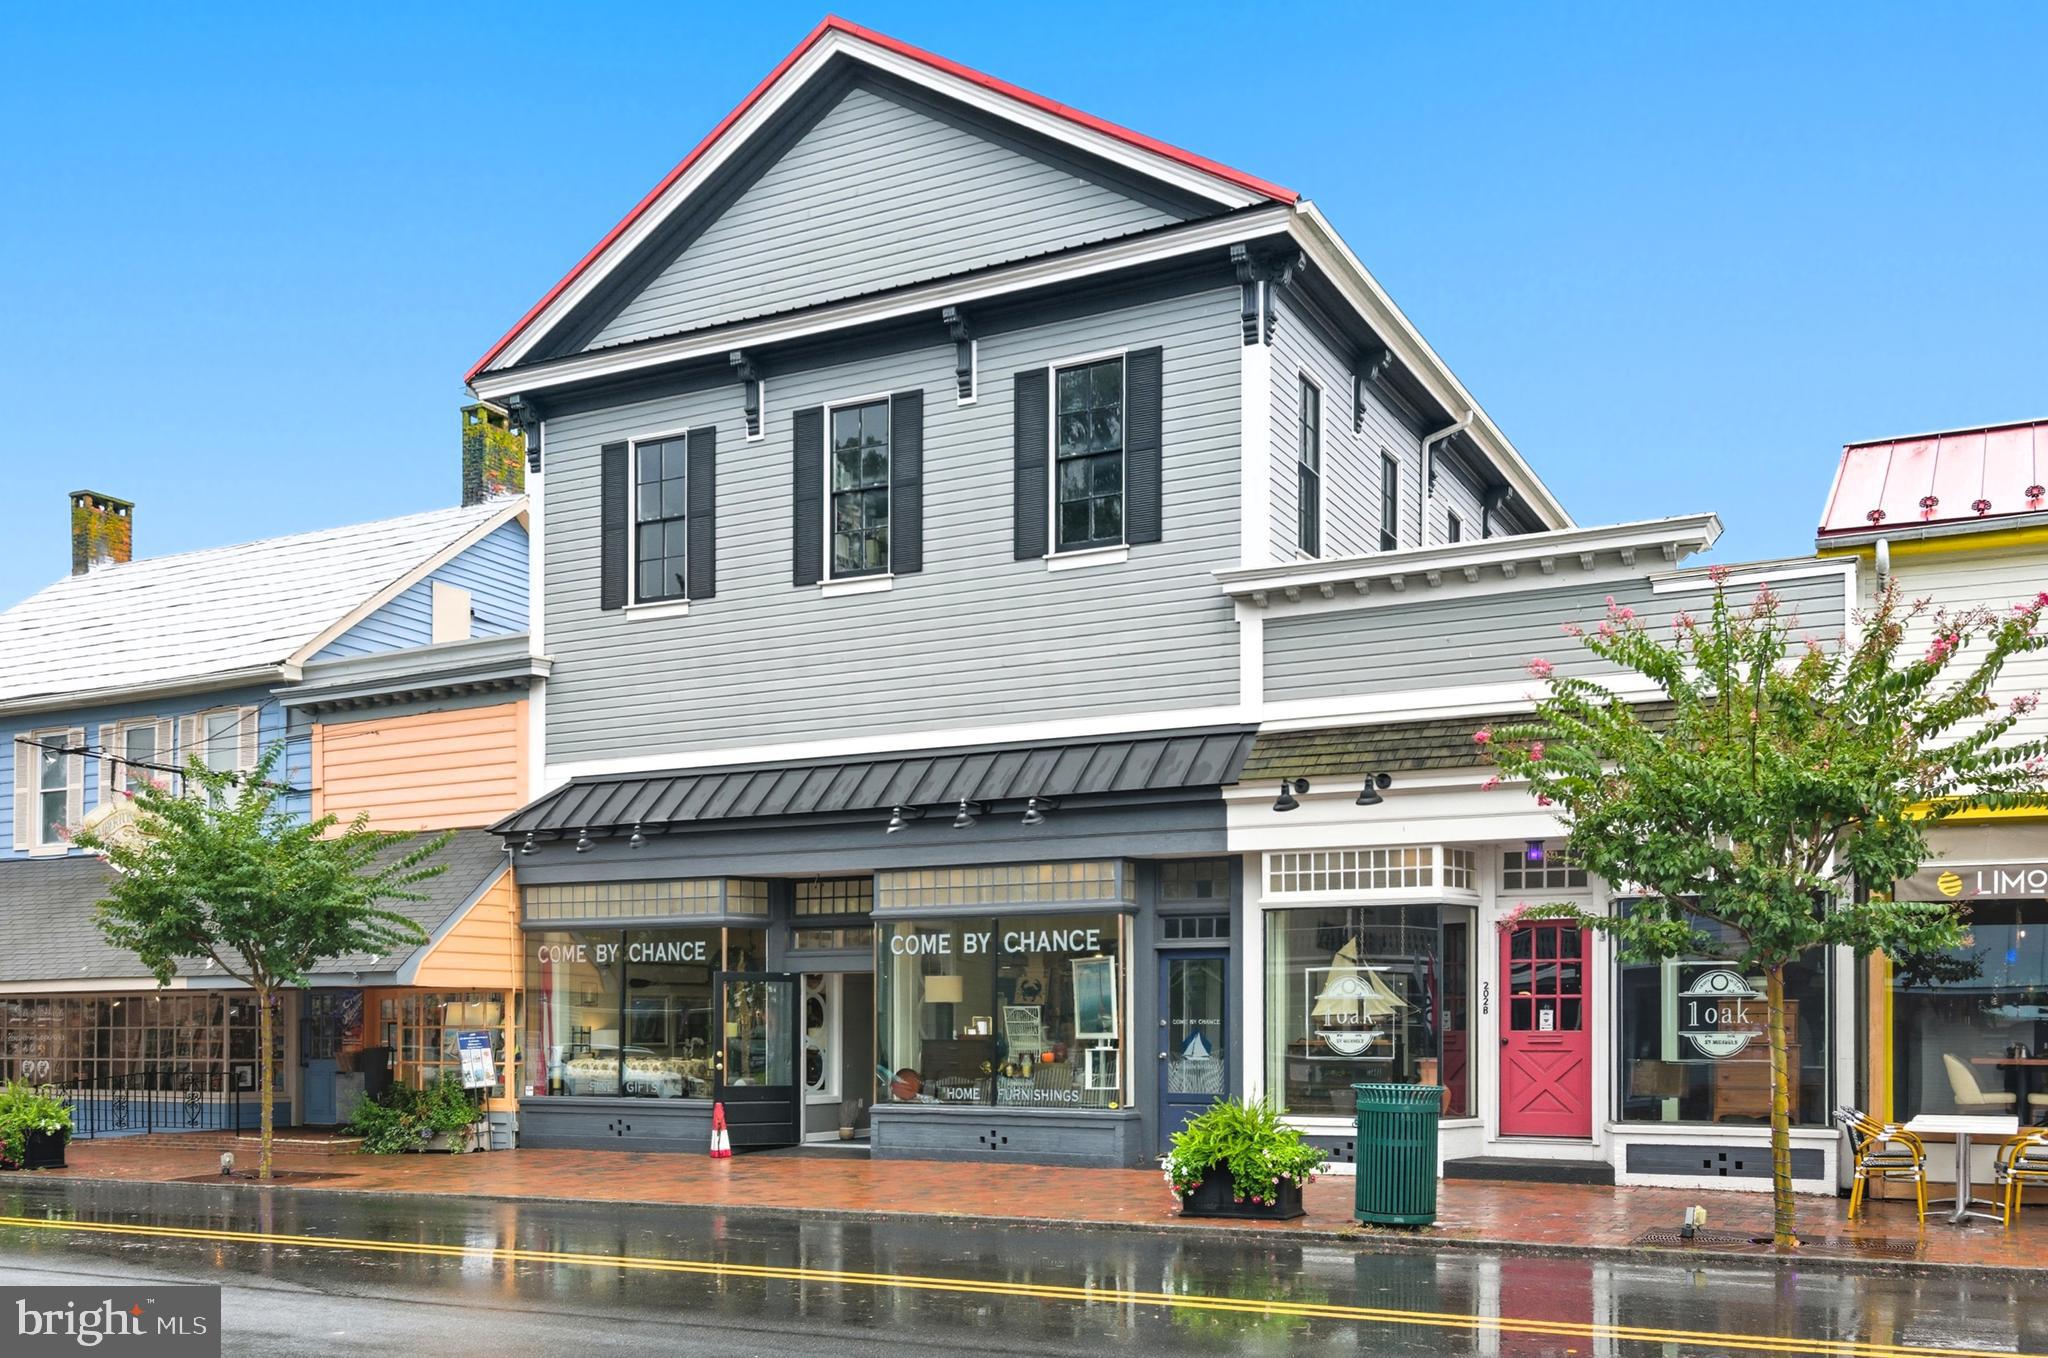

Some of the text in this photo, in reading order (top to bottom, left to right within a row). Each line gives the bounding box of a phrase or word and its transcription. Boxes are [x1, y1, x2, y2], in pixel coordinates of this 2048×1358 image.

[538, 941, 706, 963] COME BY CHANCE
[890, 929, 1100, 955] COME BY CHANCE
[1688, 1001, 1699, 1026] 1
[626, 1081, 658, 1093] GIFTS
[947, 1087, 1079, 1102] HOME FURNISHINGS
